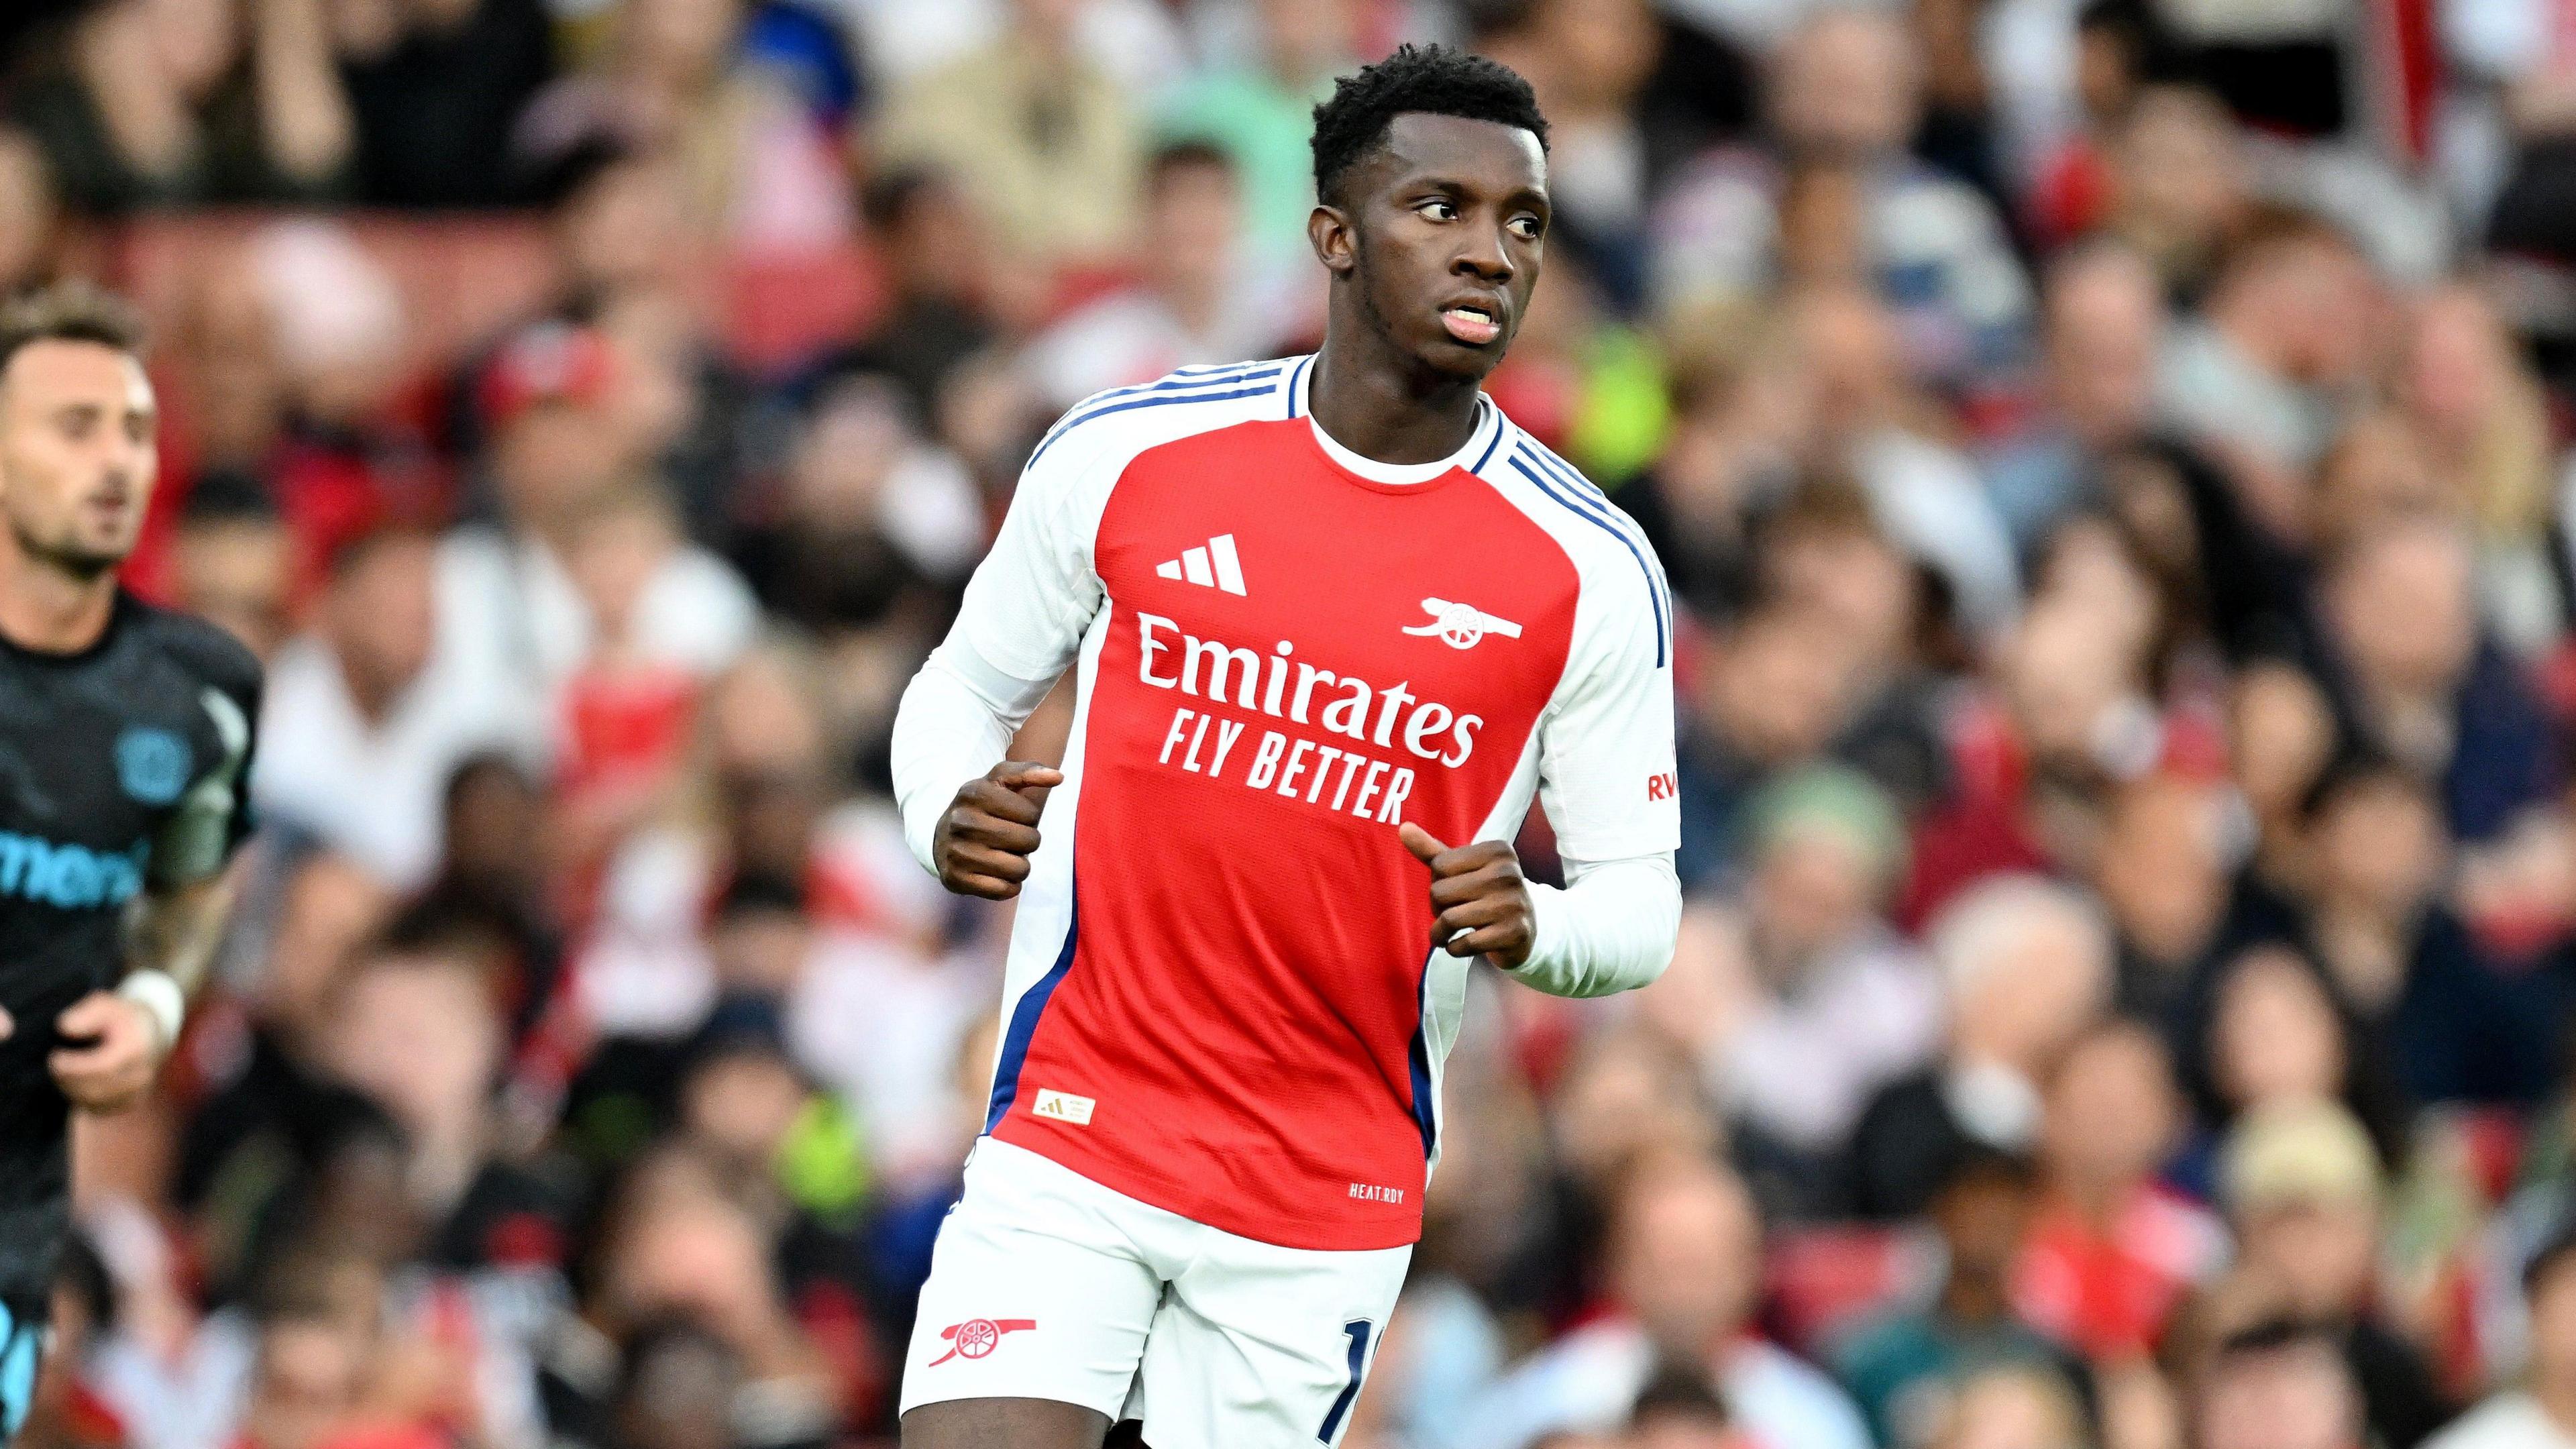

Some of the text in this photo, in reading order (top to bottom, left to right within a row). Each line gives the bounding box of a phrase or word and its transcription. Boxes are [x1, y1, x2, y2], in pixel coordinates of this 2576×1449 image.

[1136, 610, 1485, 769] Emirates
[1158, 708, 1415, 826] FLY BETTER
[1348, 1181, 1405, 1205] HEAT.RDY
